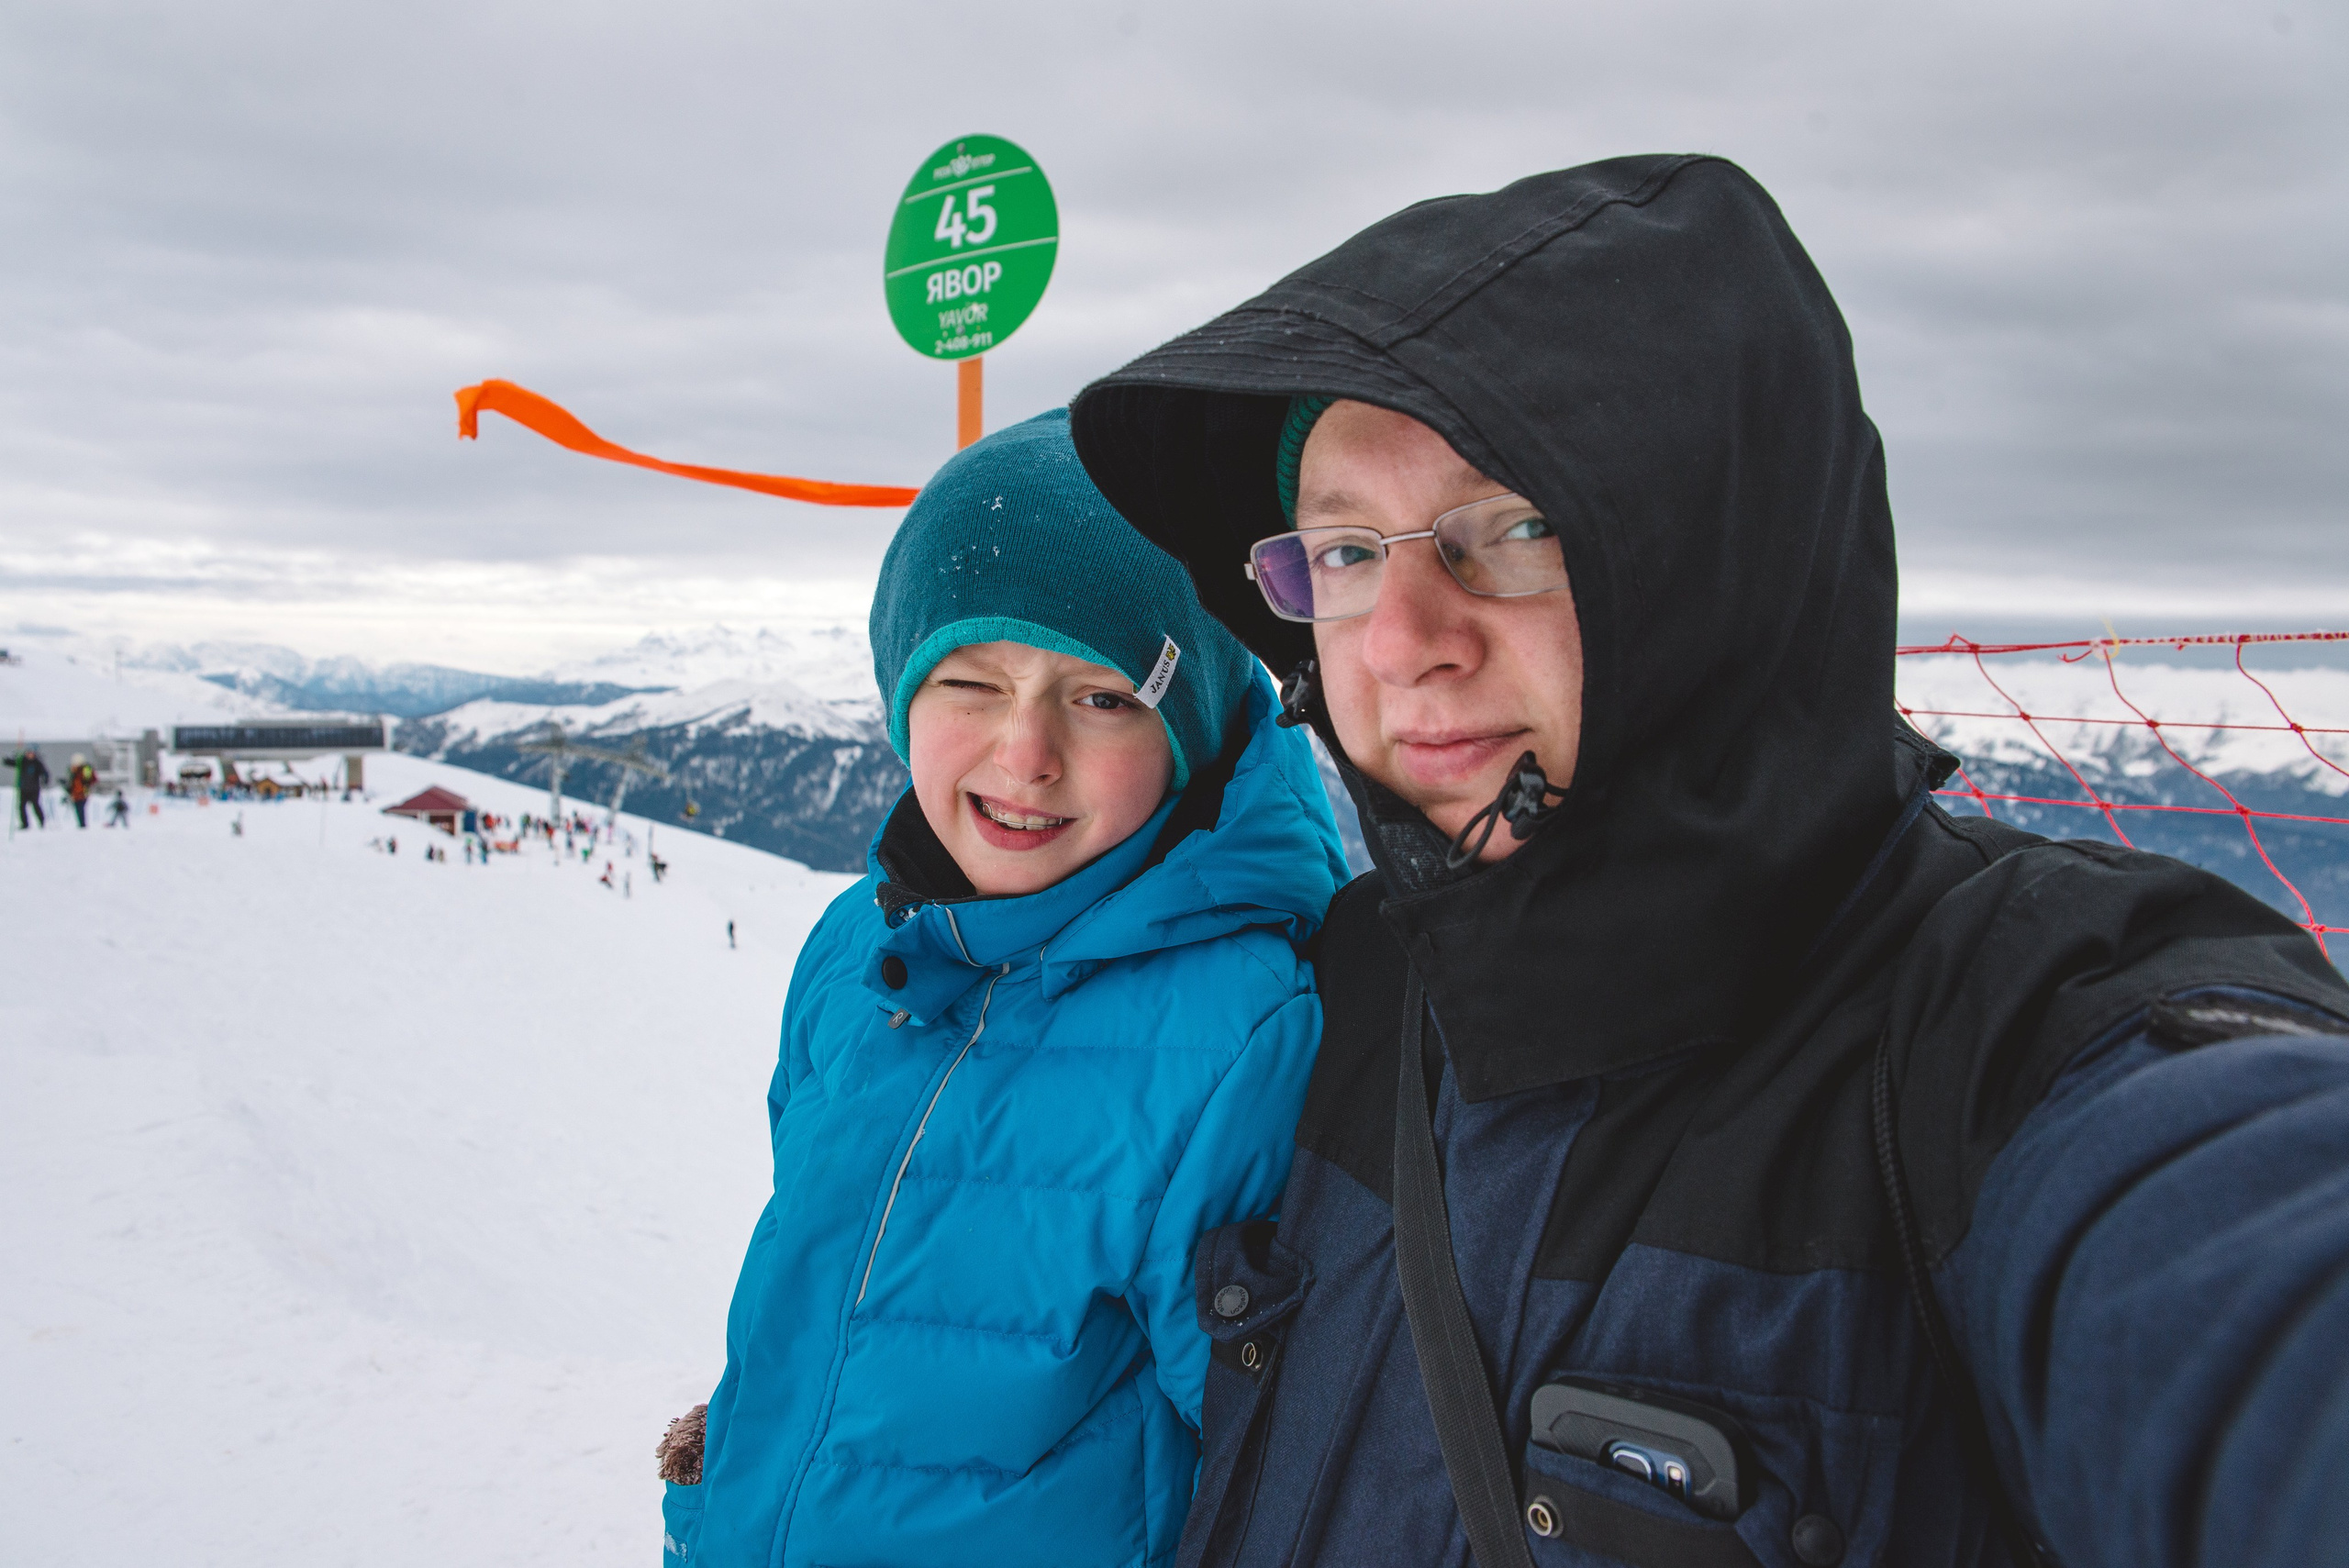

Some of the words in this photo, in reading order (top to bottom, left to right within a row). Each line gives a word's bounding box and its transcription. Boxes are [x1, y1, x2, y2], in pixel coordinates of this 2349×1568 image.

[934, 184, 997, 249] 45
[926, 261, 1002, 305] ЯВОР
[938, 303, 989, 329] YAVOR
[1150, 660, 1171, 694] JANUS
